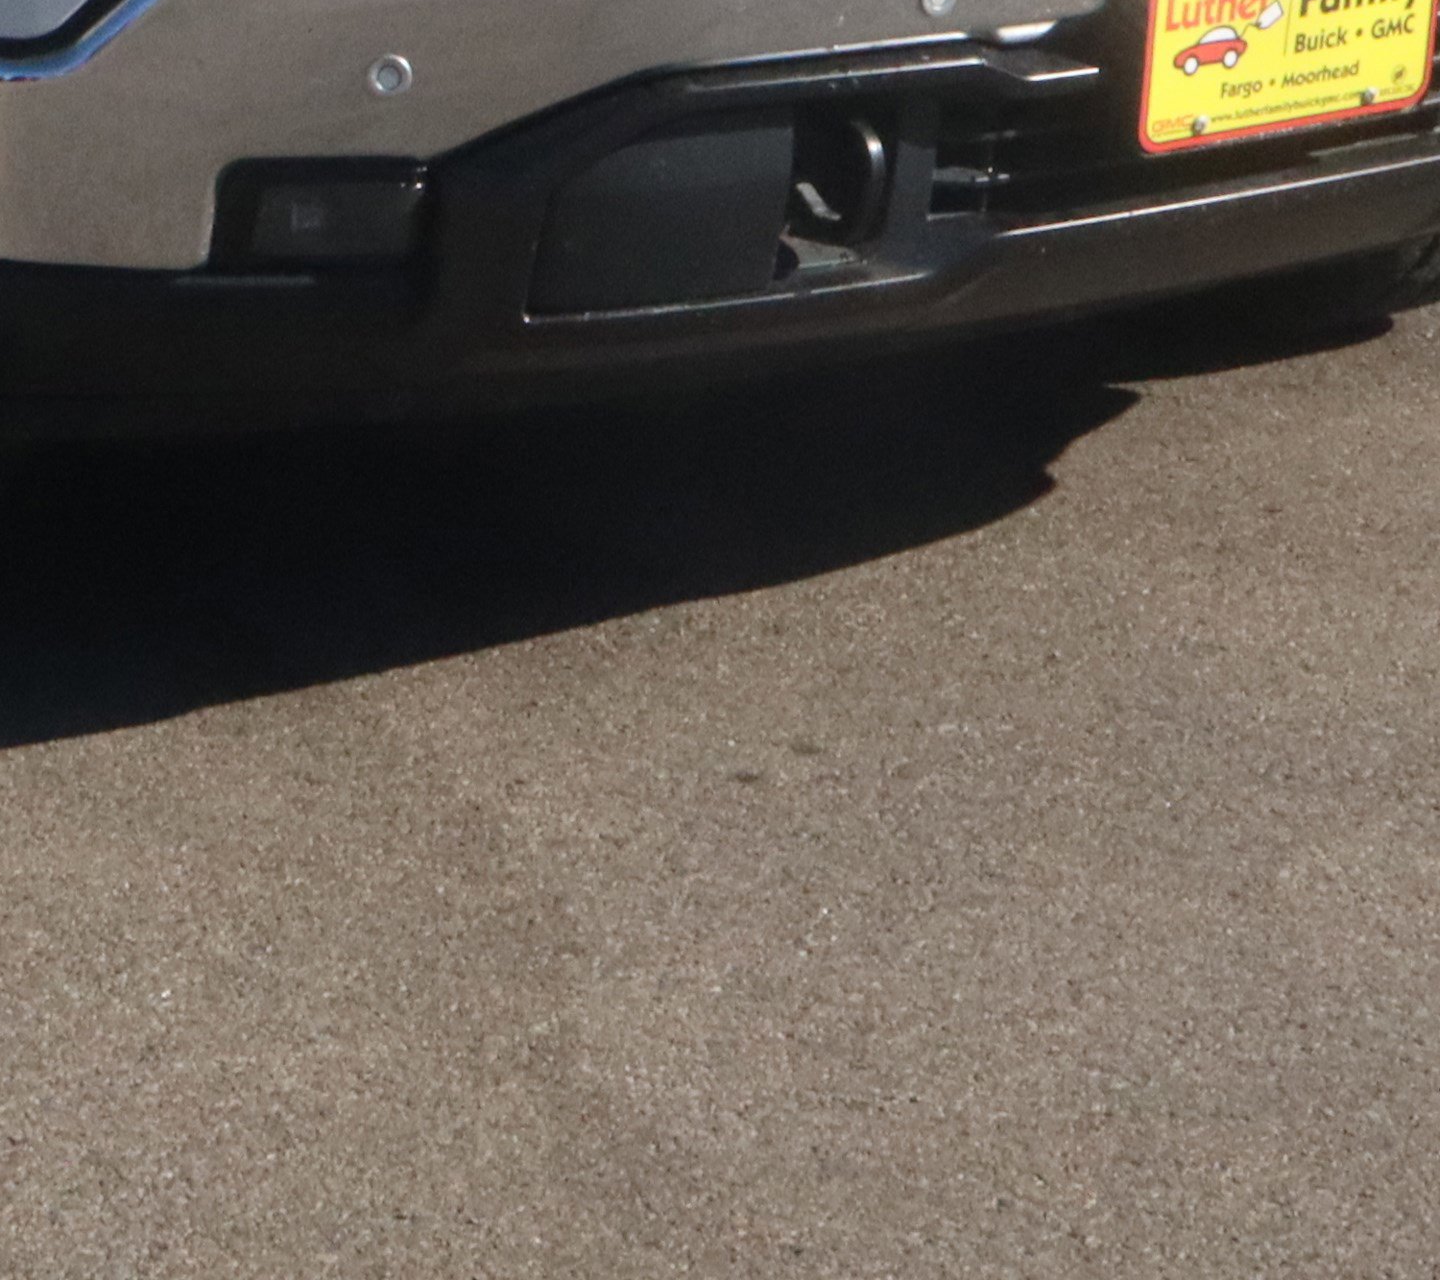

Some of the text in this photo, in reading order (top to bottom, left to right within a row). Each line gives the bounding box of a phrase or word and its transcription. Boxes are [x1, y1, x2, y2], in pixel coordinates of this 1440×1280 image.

[1294, 13, 1416, 55] Buick GMC
[1220, 61, 1360, 100] Fargo Moorhead
